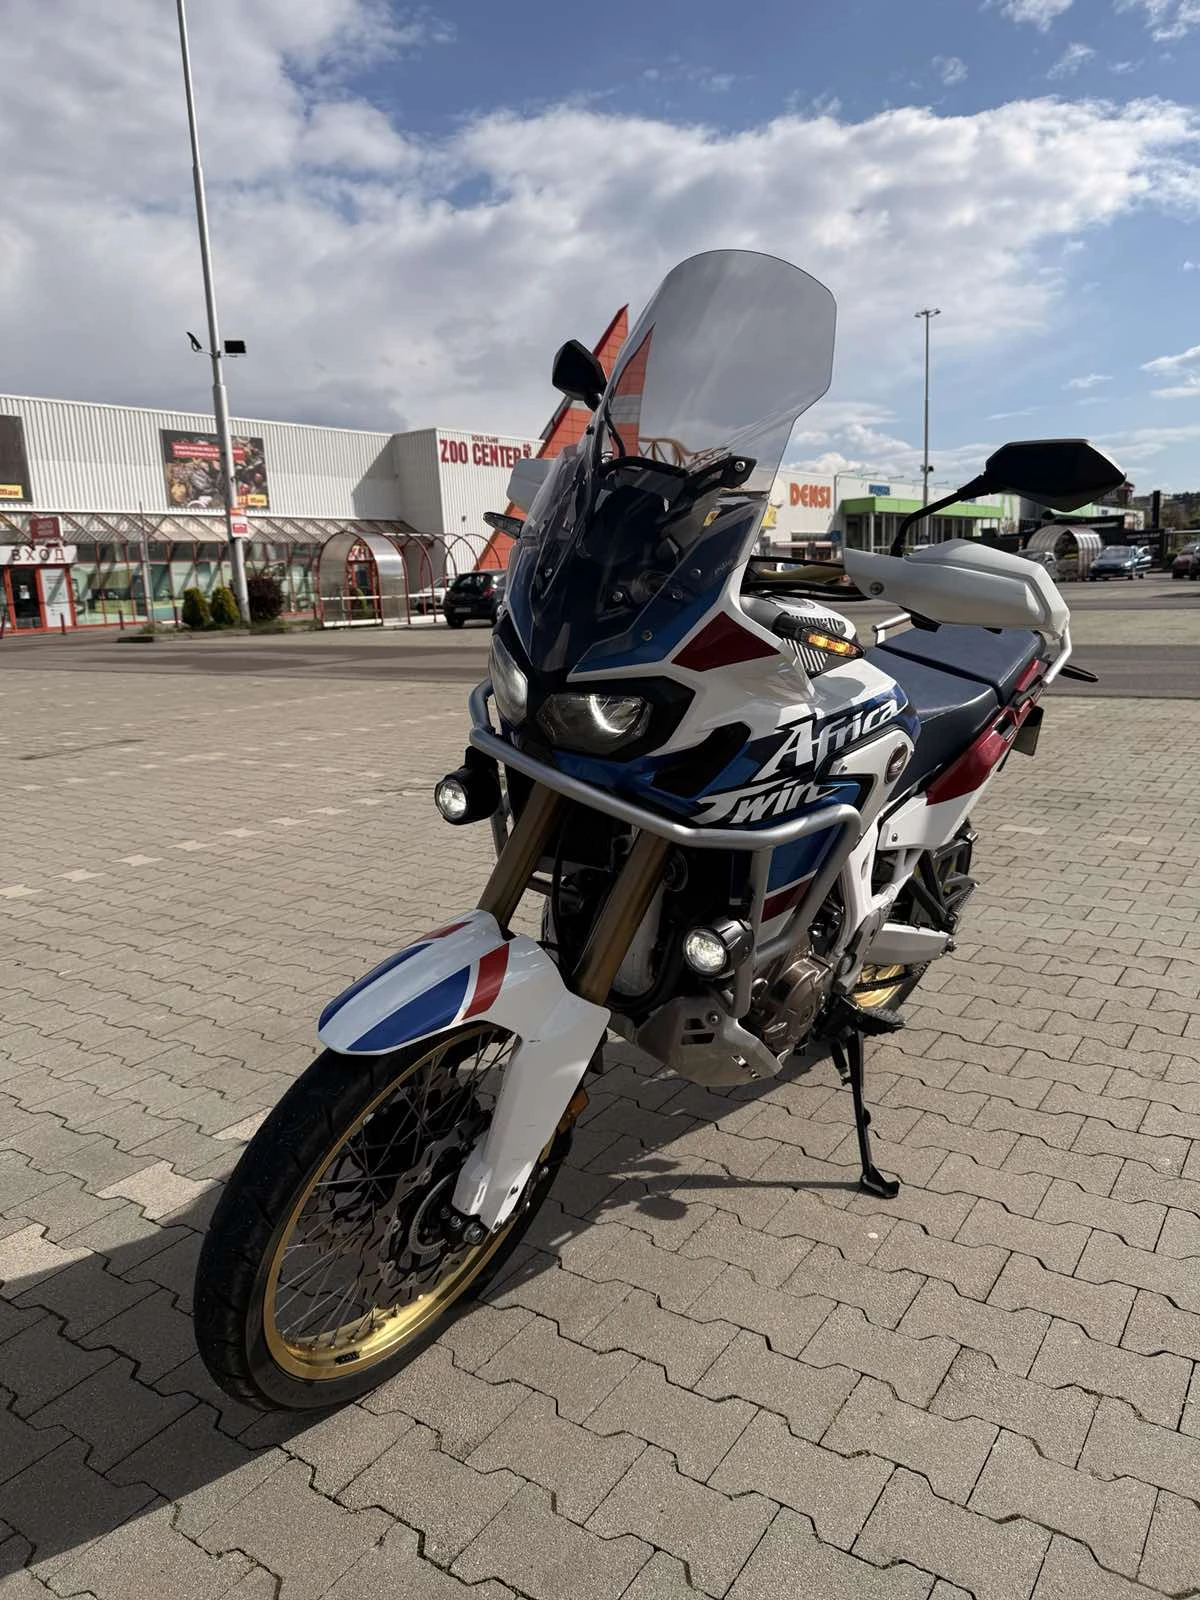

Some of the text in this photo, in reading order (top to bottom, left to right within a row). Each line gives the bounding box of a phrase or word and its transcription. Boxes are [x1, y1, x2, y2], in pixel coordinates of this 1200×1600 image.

[440, 439, 468, 464] ZOO
[790, 482, 831, 509] DENSI
[11, 548, 66, 562] ВХОД
[751, 699, 900, 782] Africa
[691, 776, 841, 825] Twin
